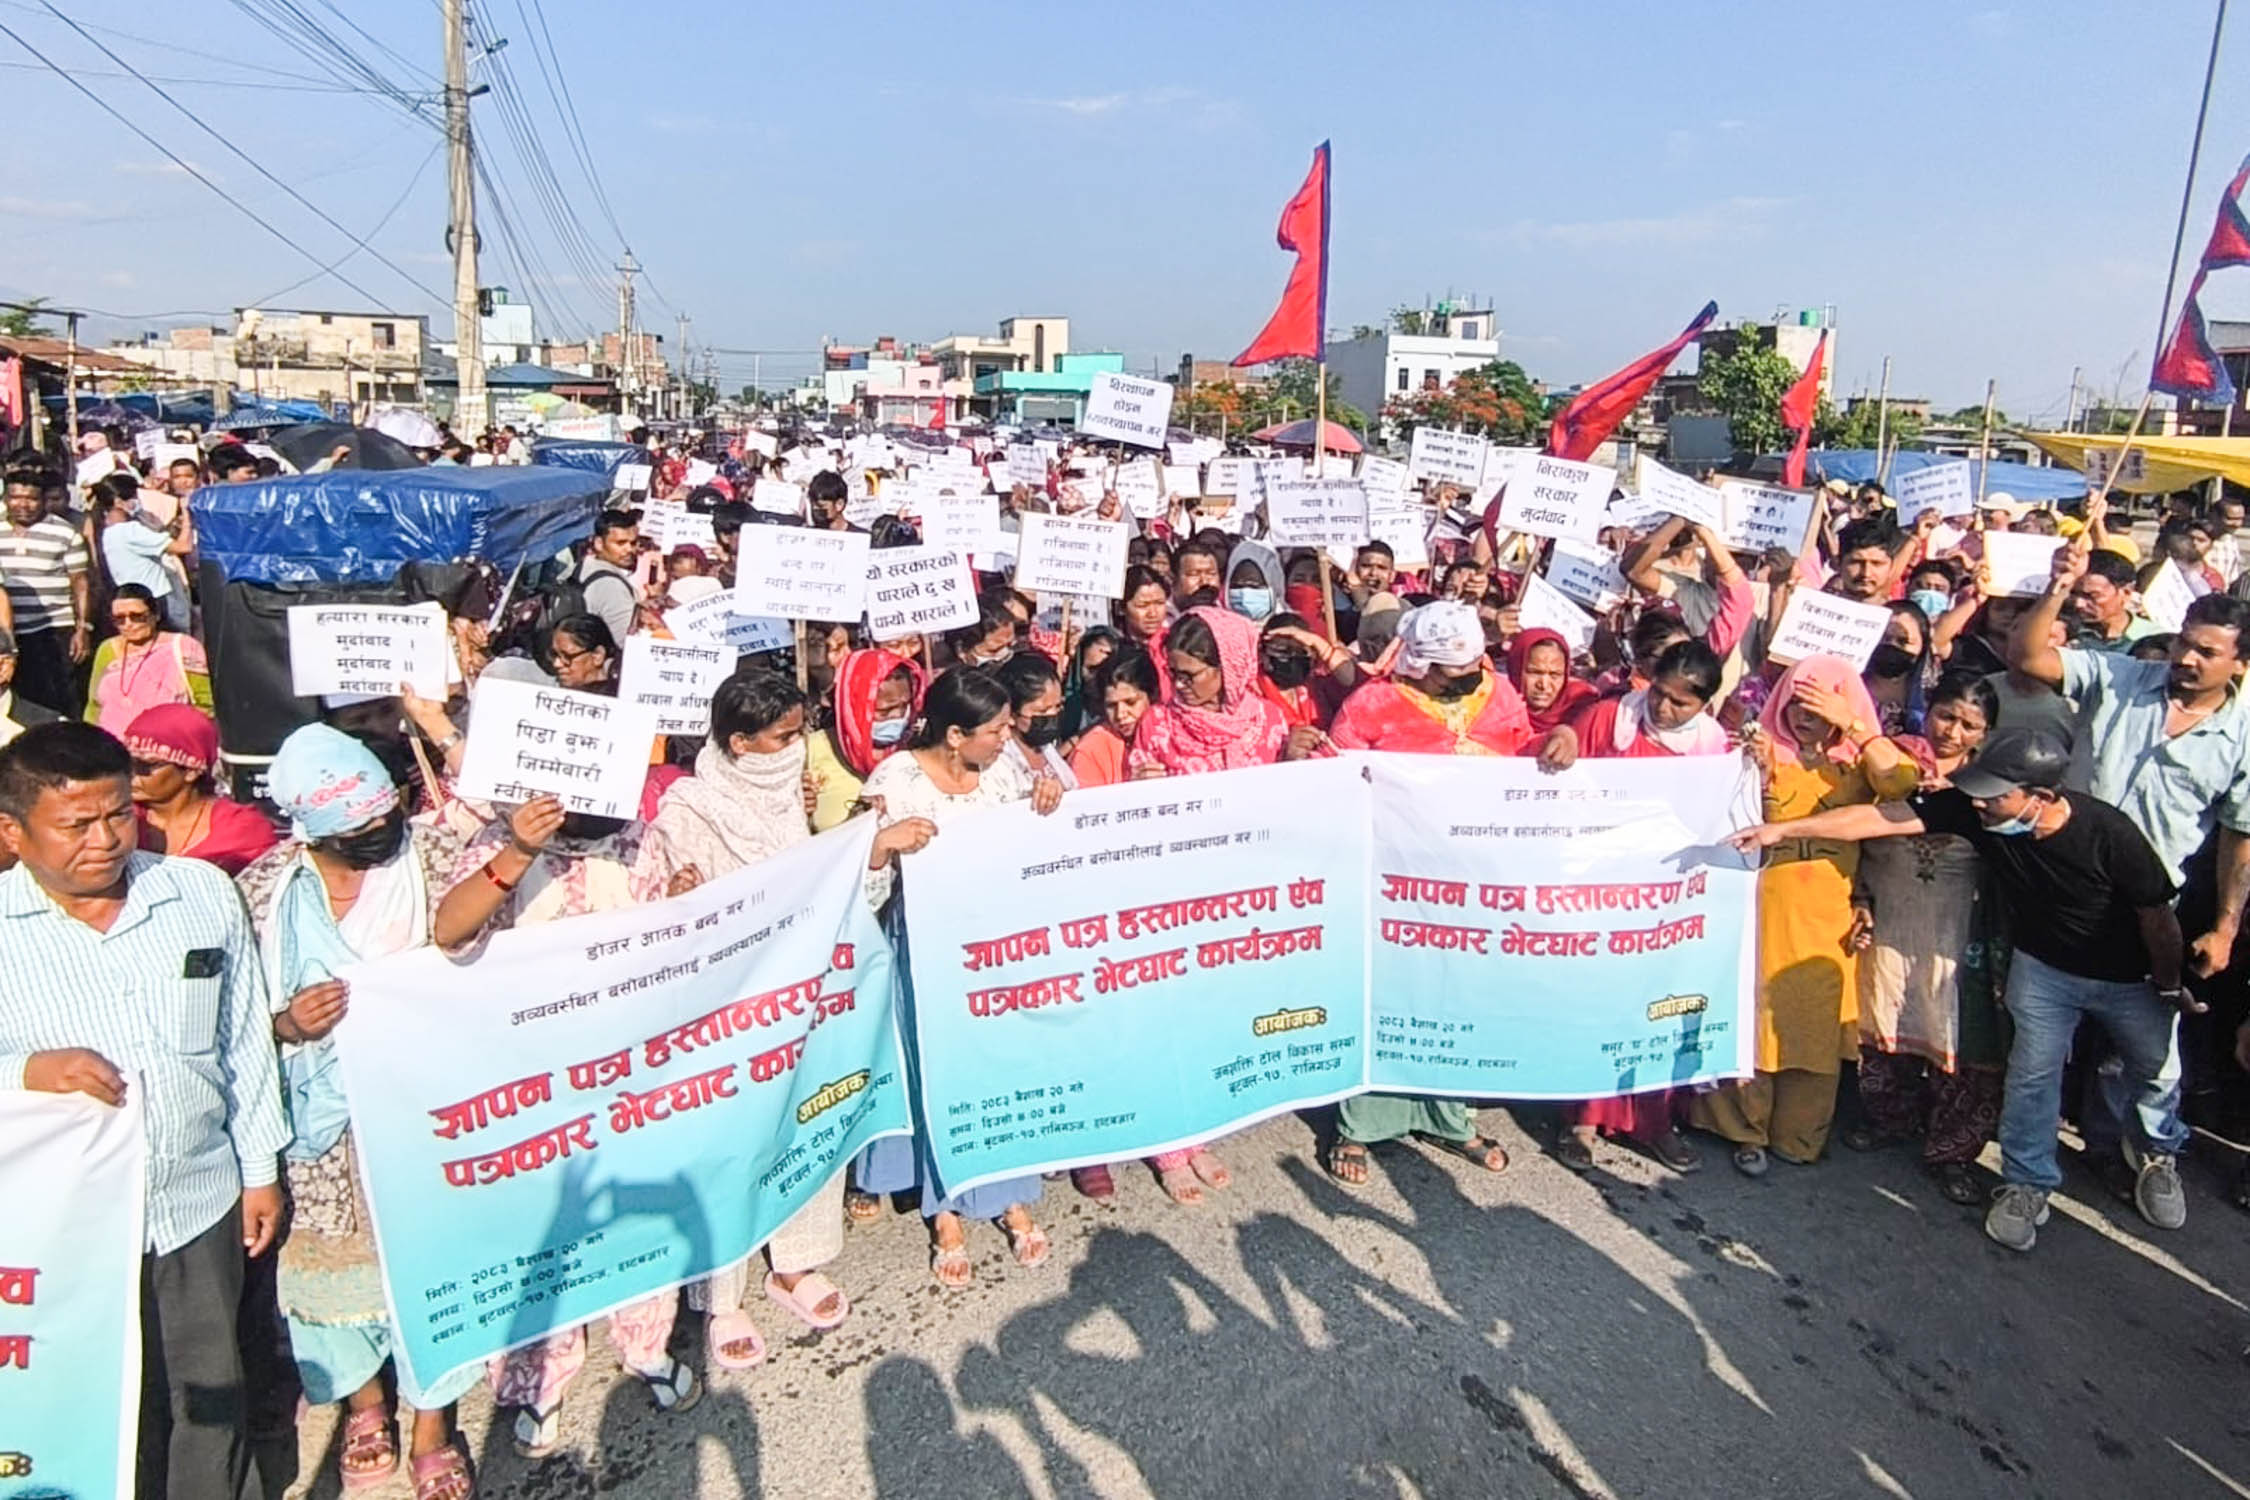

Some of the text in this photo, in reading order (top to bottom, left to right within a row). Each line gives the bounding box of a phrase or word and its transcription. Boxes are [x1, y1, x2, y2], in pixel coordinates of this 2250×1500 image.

[1533, 485, 1579, 504] सरकार
[888, 550, 958, 578] सरकारको
[316, 611, 430, 626] हत्यारा सरकार
[874, 609, 906, 628] पायो
[536, 691, 611, 721] पिडीतको
[516, 719, 556, 744] पिडा
[570, 794, 596, 814] गर
[1074, 813, 1108, 831] डोजर
[1157, 802, 1180, 819] बन्द
[1186, 799, 1203, 815] गर
[1020, 854, 1083, 881] अव्यवस्थित
[1169, 832, 1229, 855] व्यवस्थापन
[1235, 829, 1252, 845] गर
[1381, 873, 1468, 908] ज्ञापन
[1479, 884, 1527, 912] पत्र
[1535, 881, 1683, 915] हस्तान्तरण
[585, 937, 631, 961] डोजर
[695, 913, 719, 931] बन्द
[726, 899, 745, 918] गर
[962, 926, 1051, 972] ज्ञापन
[1060, 914, 1108, 949] पत्र
[1117, 885, 1278, 940] हस्तान्तरण
[1380, 914, 1706, 957] पत्रकार भेटघाट कार्यक्रम
[511, 991, 599, 1026] अव्यवस्थित
[707, 928, 772, 966] व्यवस्थापन
[776, 914, 794, 935] गर
[966, 924, 1324, 1018] पत्रकार भेटघाट कार्यक्रम
[1260, 1048, 1282, 1067] टोल
[1288, 1042, 1324, 1059] विकास
[428, 1072, 553, 1141] ज्ञापन
[568, 1047, 632, 1092] पत्र
[1049, 1085, 1064, 1098] २०
[442, 1063, 738, 1191] पत्रकार भेटघाट
[810, 1126, 836, 1150] टोल
[471, 1263, 508, 1285] २०८३
[561, 1241, 579, 1255] २०
